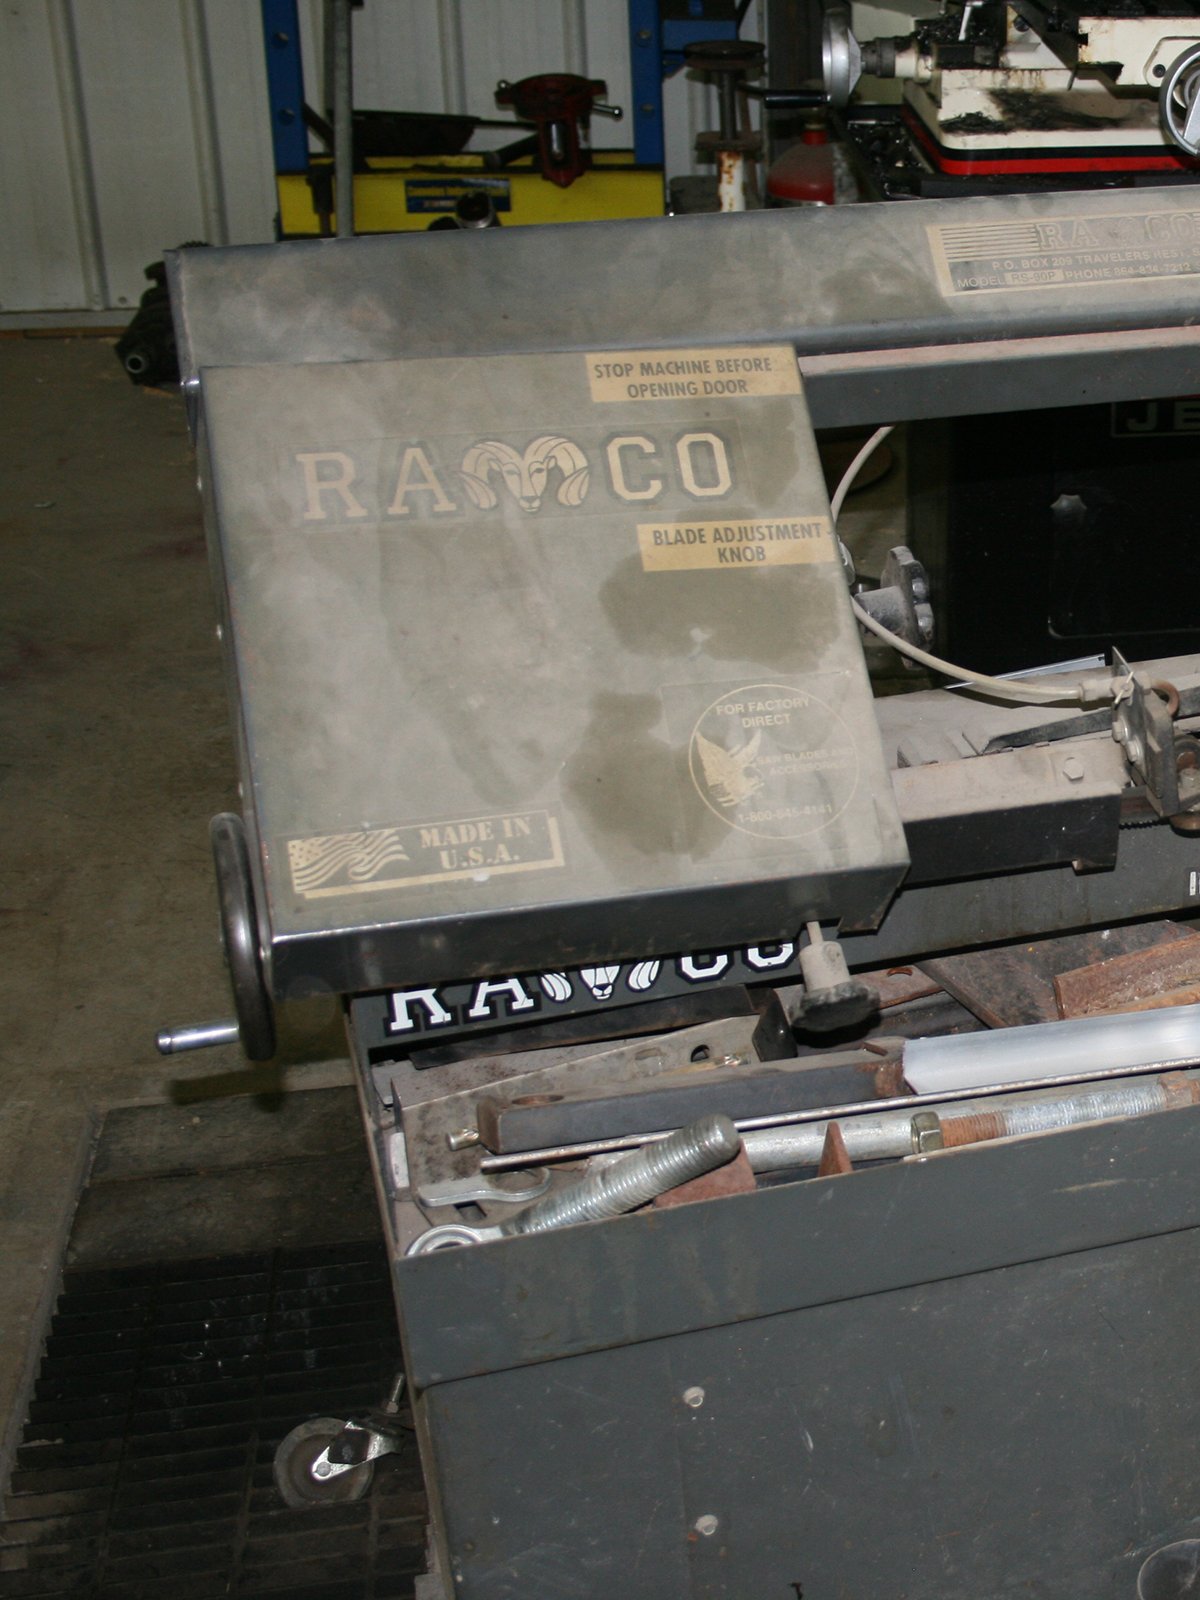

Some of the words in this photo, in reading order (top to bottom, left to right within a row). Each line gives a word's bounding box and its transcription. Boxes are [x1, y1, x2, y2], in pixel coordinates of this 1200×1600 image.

[1021, 256, 1049, 269] BOX
[1075, 250, 1151, 266] TRAVELERS
[957, 276, 1005, 288] MODEL
[1065, 268, 1107, 280] PHONE
[594, 363, 634, 379] STOP
[640, 360, 711, 377] MACHINE
[716, 357, 772, 373] BEFORE
[627, 381, 698, 398] OPENING
[704, 379, 748, 395] DOOR
[653, 528, 707, 545] BLADE
[713, 522, 822, 543] ADJUSTMENT
[717, 546, 766, 563] KNOB
[716, 703, 745, 716] FOR
[748, 697, 810, 713] FACTORY
[742, 713, 792, 728] DIRECT
[420, 822, 494, 849] MADE
[503, 816, 532, 839] IN
[439, 844, 520, 870] U.S.A.
